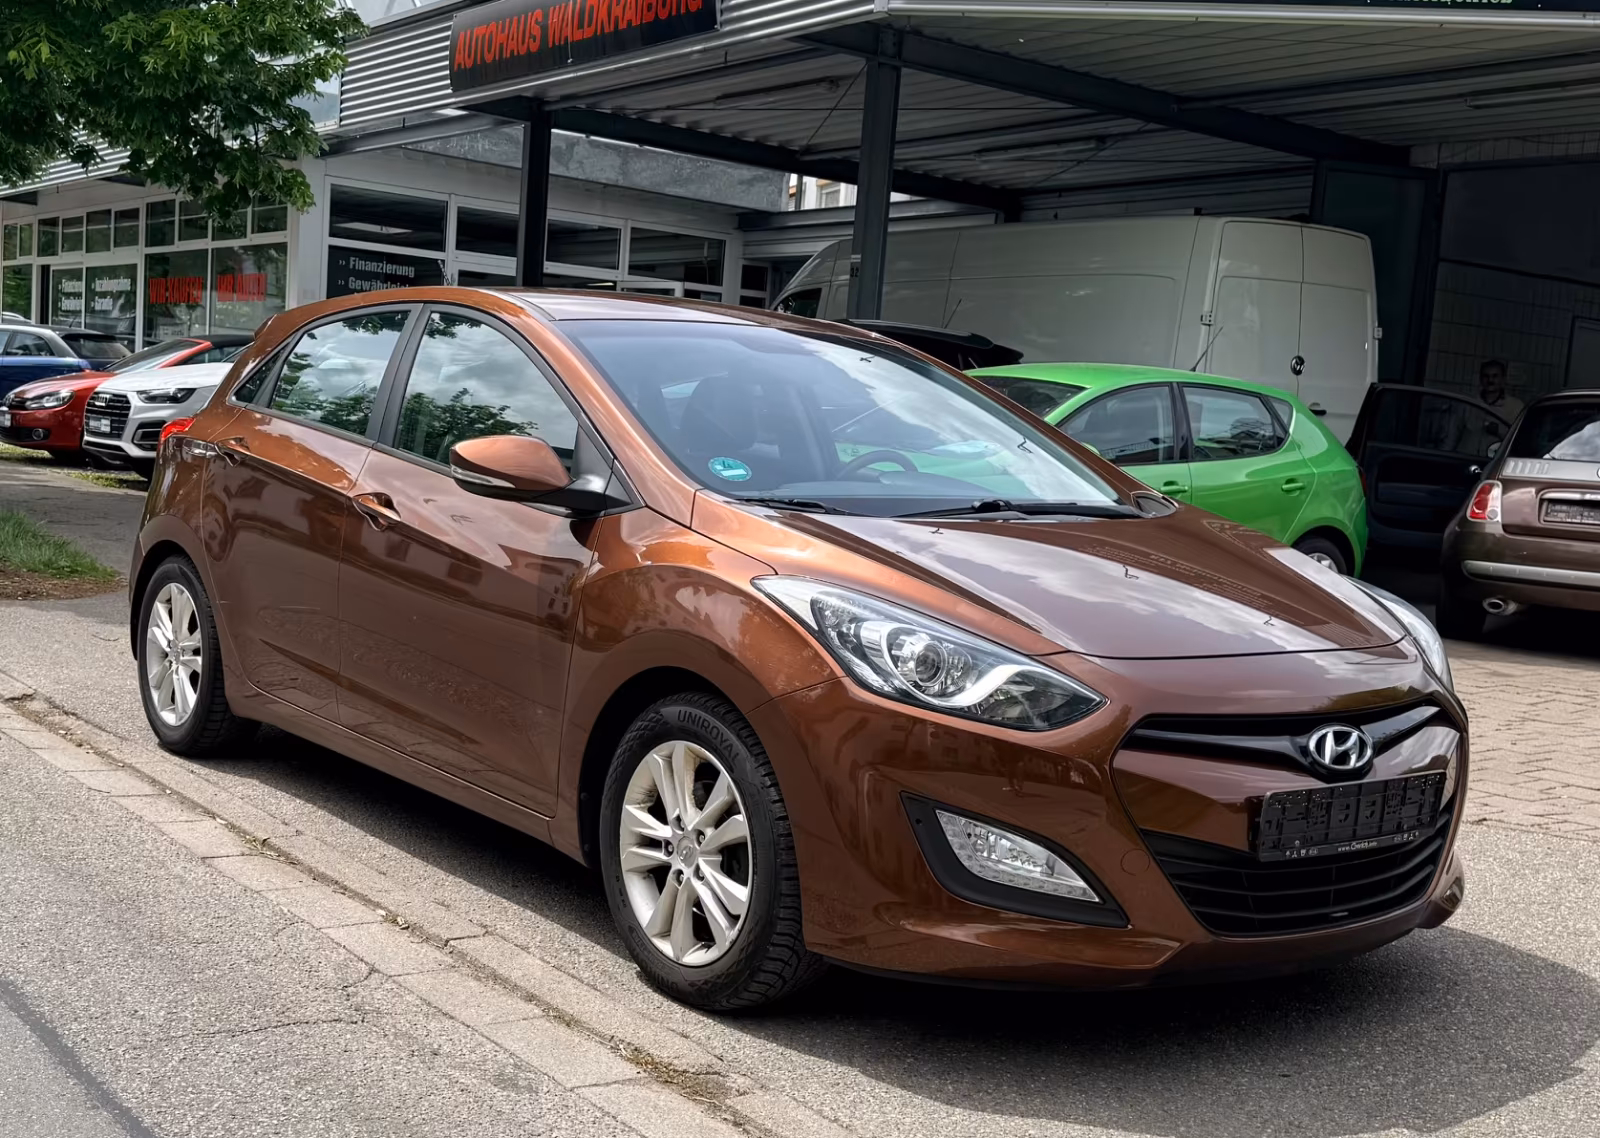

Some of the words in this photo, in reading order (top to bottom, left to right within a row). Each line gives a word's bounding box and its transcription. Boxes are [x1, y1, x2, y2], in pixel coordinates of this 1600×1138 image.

[454, 9, 543, 71] AUTOHAUS
[349, 256, 415, 278] Finanzierung
[677, 709, 740, 764] UNIROYAL
